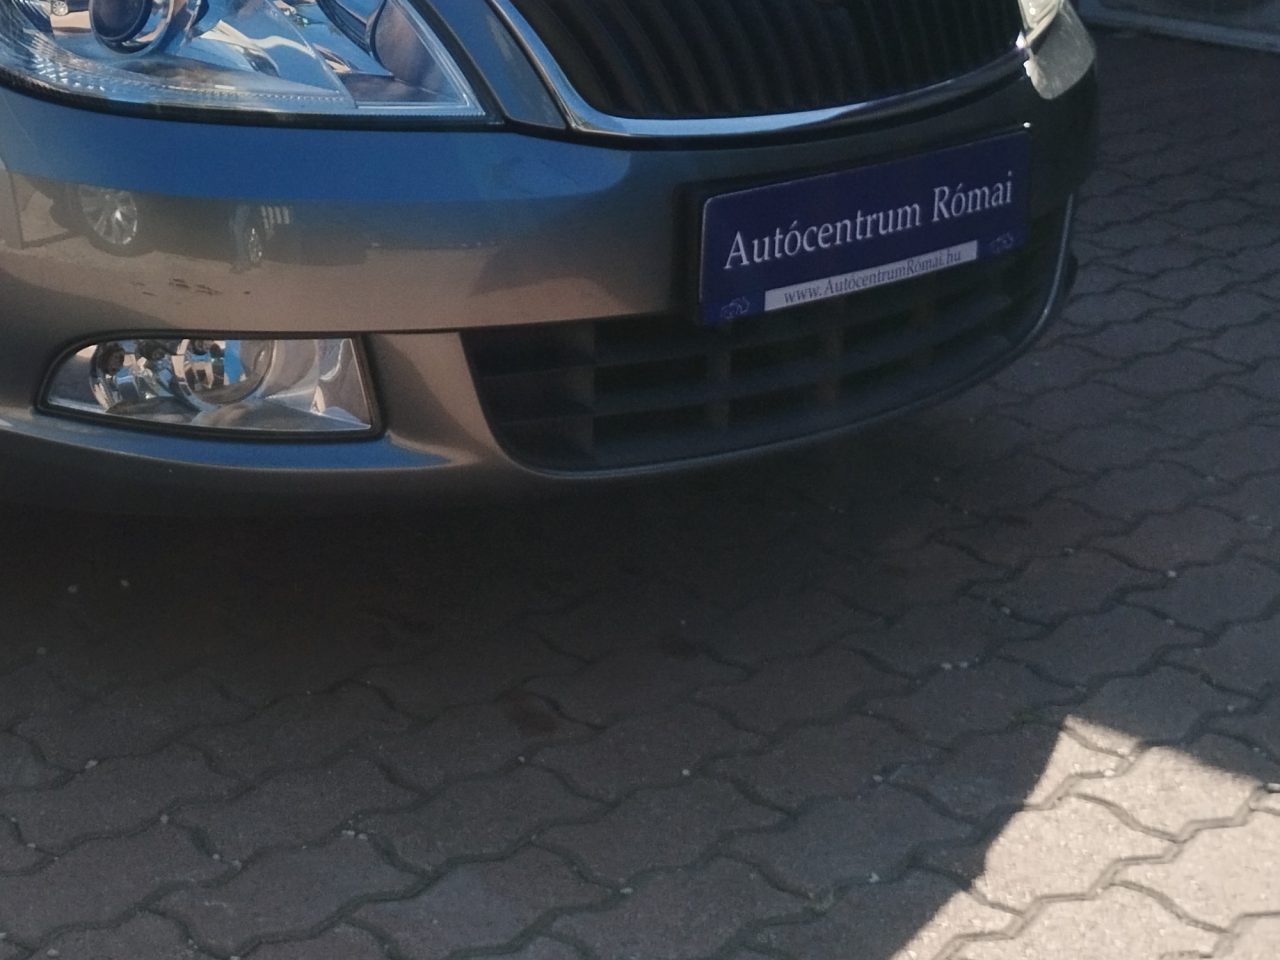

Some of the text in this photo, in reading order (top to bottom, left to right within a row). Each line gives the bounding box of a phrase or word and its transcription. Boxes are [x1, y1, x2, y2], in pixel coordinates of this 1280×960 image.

[723, 169, 1013, 270] Autócentrum Római
[783, 248, 962, 305] www.AutócentrumRómai.hu
